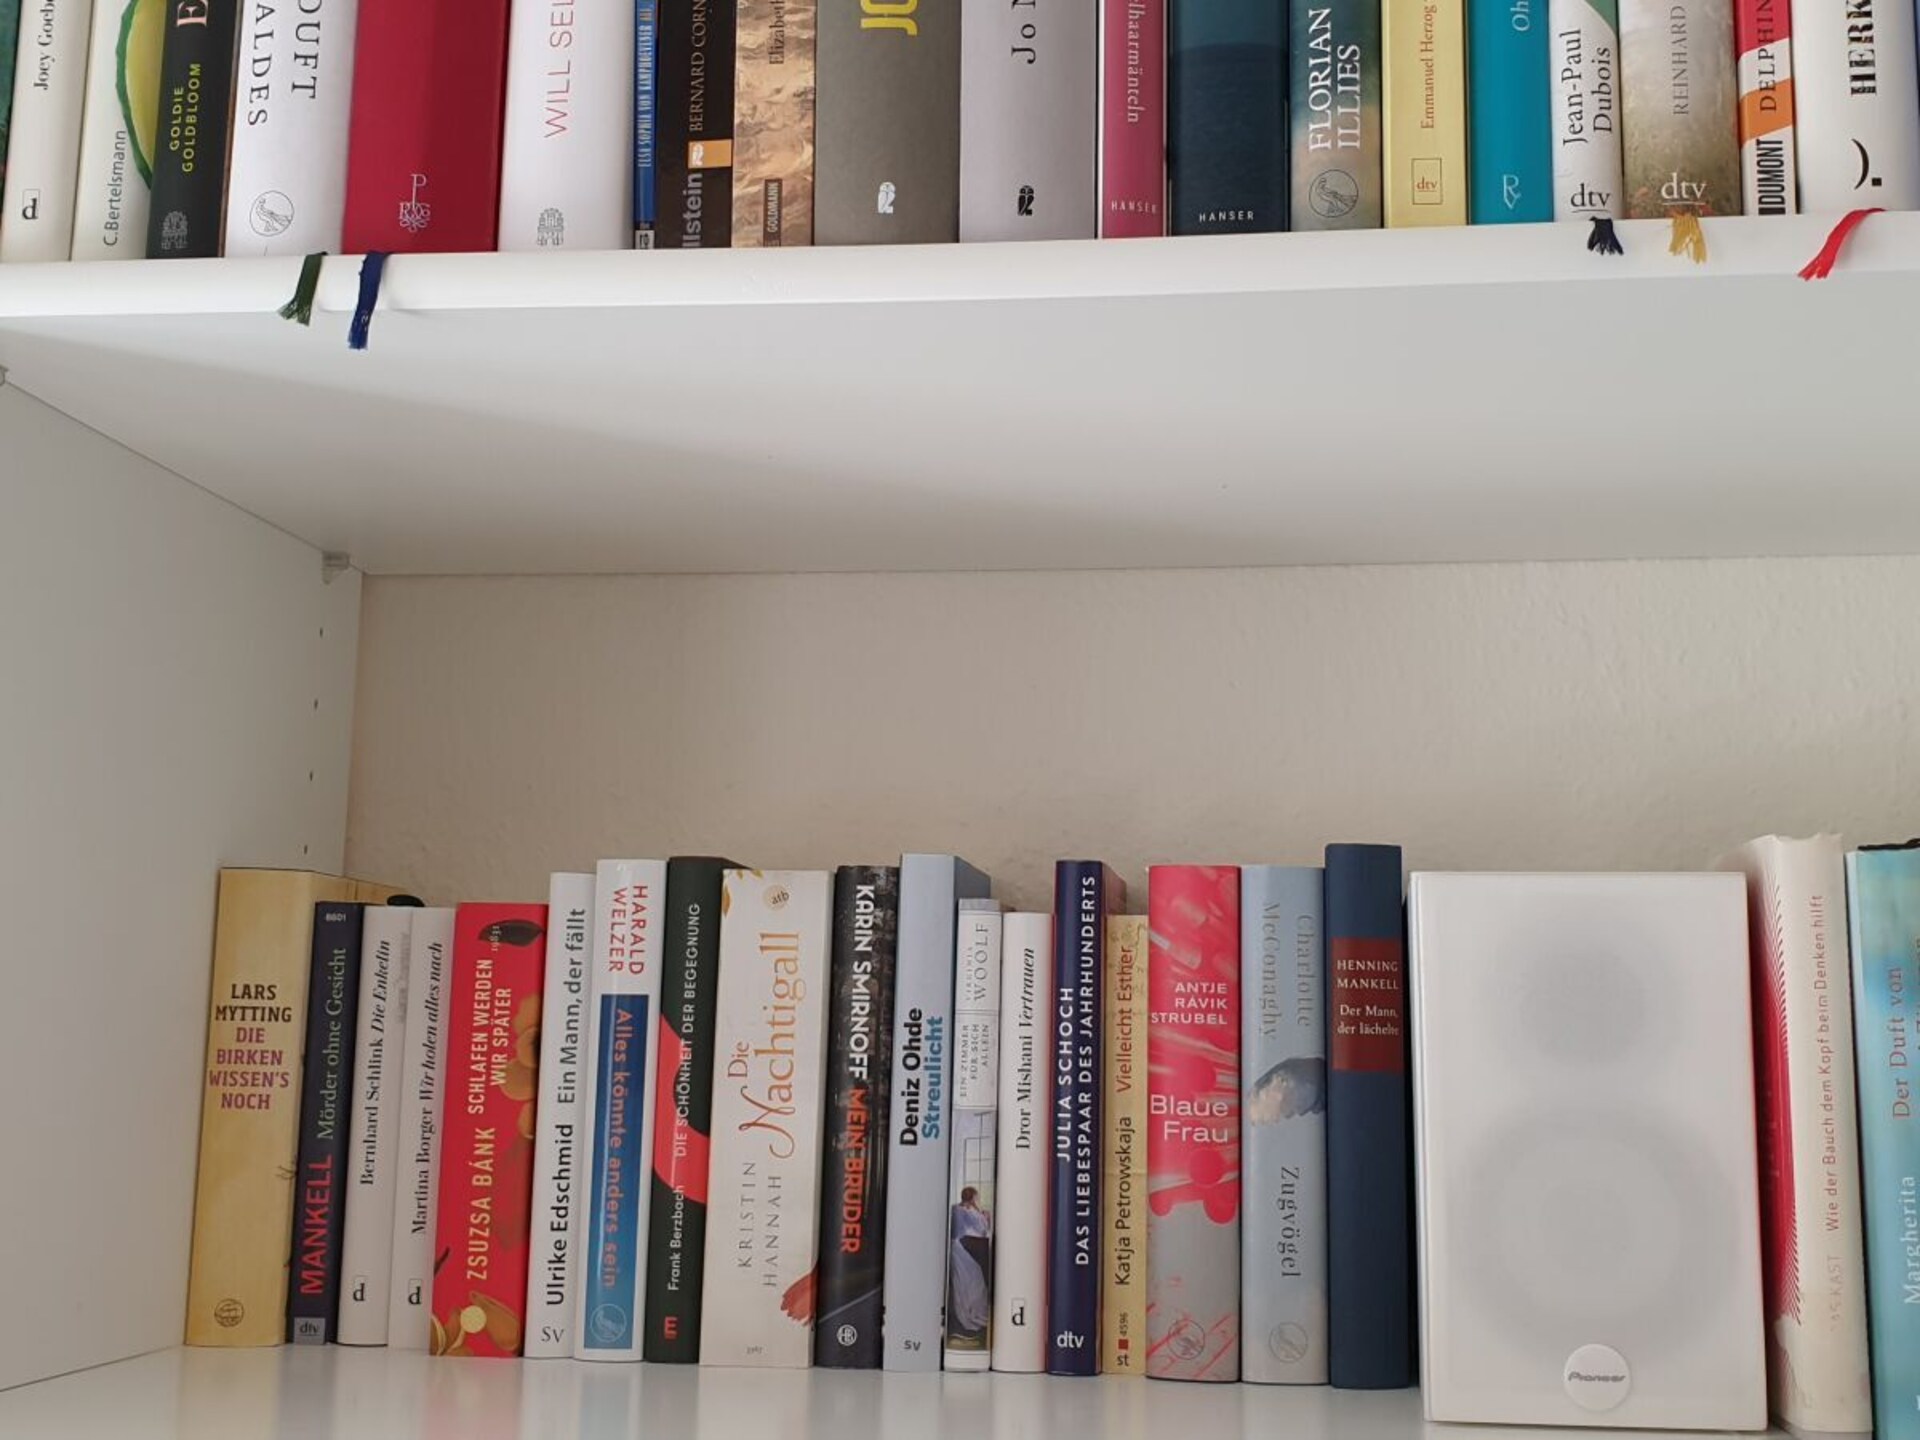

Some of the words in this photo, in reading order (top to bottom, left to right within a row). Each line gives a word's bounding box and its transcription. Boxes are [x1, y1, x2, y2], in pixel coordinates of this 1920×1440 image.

[1011, 23, 1036, 64] Jo
[1421, 4, 1437, 51] Herzog
[33, 53, 55, 90] Joey
[1308, 7, 1332, 151] FLORIAN
[1559, 28, 1587, 146] Jean-Paul
[1670, 5, 1689, 116] REINHARD
[182, 63, 201, 172] GOLDBLOOM
[544, 60, 570, 138] WILL
[689, 52, 705, 132] BERNARD
[1337, 44, 1360, 149] ILLIES
[1421, 57, 1435, 129] Emmanuel
[1592, 47, 1612, 133] Dubois
[169, 87, 184, 150] GOLDIE
[104, 130, 126, 247] C.Bertelsmann
[767, 181, 780, 233] GOLDMANN
[1111, 200, 1158, 215] HANSER
[1416, 177, 1438, 190] dtv
[1570, 183, 1611, 207] dtv
[1661, 173, 1707, 199] dtv
[1198, 210, 1254, 223] HANSER
[565, 908, 586, 953] fällt
[608, 887, 627, 972] WELZER
[628, 885, 648, 975] HARALD
[853, 884, 875, 952] KARIN
[1811, 895, 1823, 928] hilft
[373, 940, 390, 1002] Enkelin
[428, 942, 443, 982] nach
[563, 957, 581, 994] der
[684, 903, 700, 998] BEGEGNUNG
[974, 923, 988, 1001] WOOLF
[1079, 876, 1095, 1038] JAHRHUNDERTS
[1117, 946, 1132, 1001] Esther
[1259, 902, 1282, 1040] McConaghy
[1297, 914, 1316, 1027] Charlotte
[1336, 959, 1398, 972] HENNING
[1814, 932, 1828, 990] Denken
[231, 983, 277, 1001] LARS
[325, 948, 346, 1016] Gesicht
[425, 983, 441, 1024] alles
[473, 959, 493, 1027] WERDEN
[1019, 948, 1035, 1028] Vertrauen
[1175, 982, 1228, 994] ANTJE
[1336, 978, 1399, 990] MANKELL
[1340, 1004, 1360, 1016] Der
[1889, 967, 1903, 1006] von
[215, 1006, 292, 1023] MYTTING
[236, 1027, 266, 1043] DIE
[371, 1004, 386, 1032] Die
[491, 988, 512, 1047] SPÄTER
[559, 998, 582, 1065] Mann,
[614, 1009, 632, 1062] Alles
[682, 1004, 695, 1032] DER
[849, 961, 872, 1080] SMIRNOFF
[902, 1008, 922, 1071] Ohde
[1059, 988, 1073, 1085] SCHOCH
[1151, 1012, 1227, 1025] STRUBEL
[1337, 1021, 1355, 1034] der
[1816, 994, 1829, 1032] beim
[216, 1049, 283, 1066] BIRKEN
[322, 1021, 341, 1065] ohne
[365, 1038, 383, 1102] Schlink
[422, 1025, 438, 1070] holen
[727, 1041, 749, 1079] Die
[738, 932, 806, 1160] Nachtigall
[1017, 1036, 1032, 1102] Mishani
[1078, 1046, 1092, 1083] DES
[1116, 1008, 1132, 1093] Vielleicht
[1817, 1035, 1834, 1074] Kopf
[1887, 1017, 1907, 1067] Duft
[209, 1070, 290, 1088] WISSEN'S
[419, 1072, 435, 1101] Wir
[468, 1033, 488, 1115] SCHLAFEN
[490, 1055, 507, 1086] WIR
[557, 1070, 576, 1103] Ein
[676, 1038, 693, 1128] SCHÖNHEIT
[921, 1016, 943, 1139] Streulicht
[1820, 1079, 1834, 1110] dem
[1892, 1078, 1909, 1118] Der
[221, 1092, 271, 1110] NOCH
[317, 1072, 337, 1140] Mörder
[609, 1072, 631, 1149] könnte
[847, 1089, 869, 1147] MEIN
[899, 1078, 920, 1146] Deniz
[1016, 1108, 1031, 1149] Dror
[1057, 1096, 1072, 1162] JULIA
[1151, 1094, 1228, 1117] Blaue
[360, 1106, 379, 1185] Bernhard
[416, 1107, 434, 1163] Borger
[468, 1128, 495, 1187] BÁNK
[674, 1131, 687, 1158] DIE
[1076, 1093, 1092, 1216] LIEBESPAAR
[1164, 1121, 1228, 1143] Frau
[1822, 1118, 1836, 1165] Bauch
[551, 1124, 574, 1232] Edschmid
[603, 1159, 624, 1233] anders
[1115, 1116, 1135, 1230] Petrowskaja
[1825, 1171, 1838, 1196] der
[300, 1154, 335, 1294] MANKELL
[411, 1170, 429, 1235] Martina
[671, 1184, 685, 1249] Berzbach
[737, 1162, 757, 1268] KRISTIN
[840, 1157, 865, 1254] BRUDER
[1277, 1166, 1301, 1278] Zugvögel
[1826, 1201, 1840, 1232] Wie
[467, 1197, 492, 1280] ZSUZSA
[763, 1176, 781, 1287] HANNAH
[1076, 1226, 1089, 1265] DAS
[1899, 1177, 1920, 1304] Margherita
[546, 1239, 567, 1306] Ulrike
[602, 1243, 620, 1289] sein
[668, 1253, 681, 1291] Frank
[1115, 1236, 1134, 1285] Katja
[541, 1326, 565, 1343] SV
[1057, 1331, 1085, 1348] dtv
[1117, 1354, 1129, 1366] st
